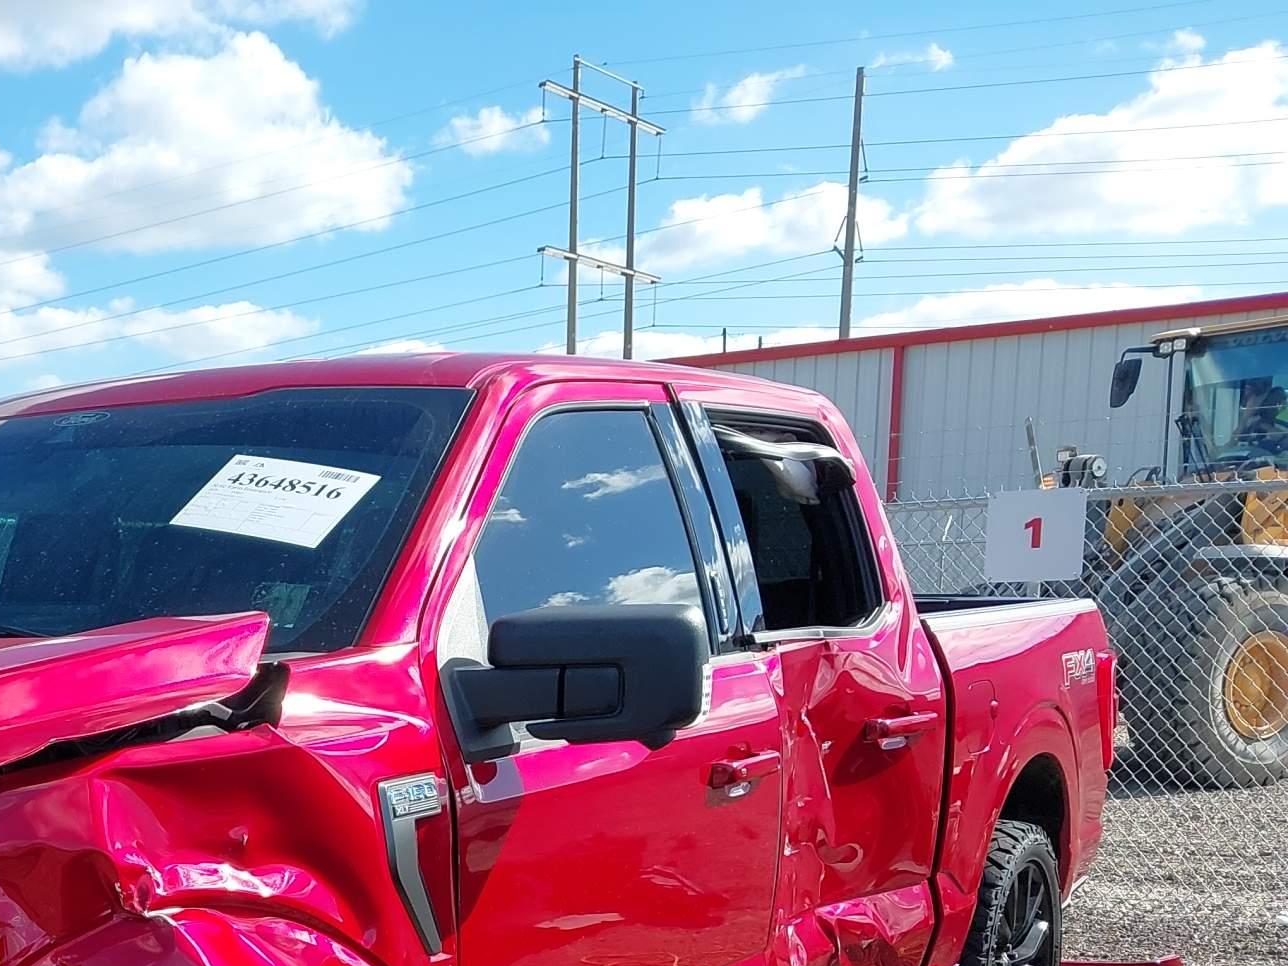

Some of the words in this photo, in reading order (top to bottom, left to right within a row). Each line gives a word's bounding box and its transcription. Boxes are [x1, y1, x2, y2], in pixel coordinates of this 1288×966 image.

[227, 472, 347, 499] 43648516
[1024, 517, 1042, 549] 1
[1062, 648, 1095, 689] FX4
